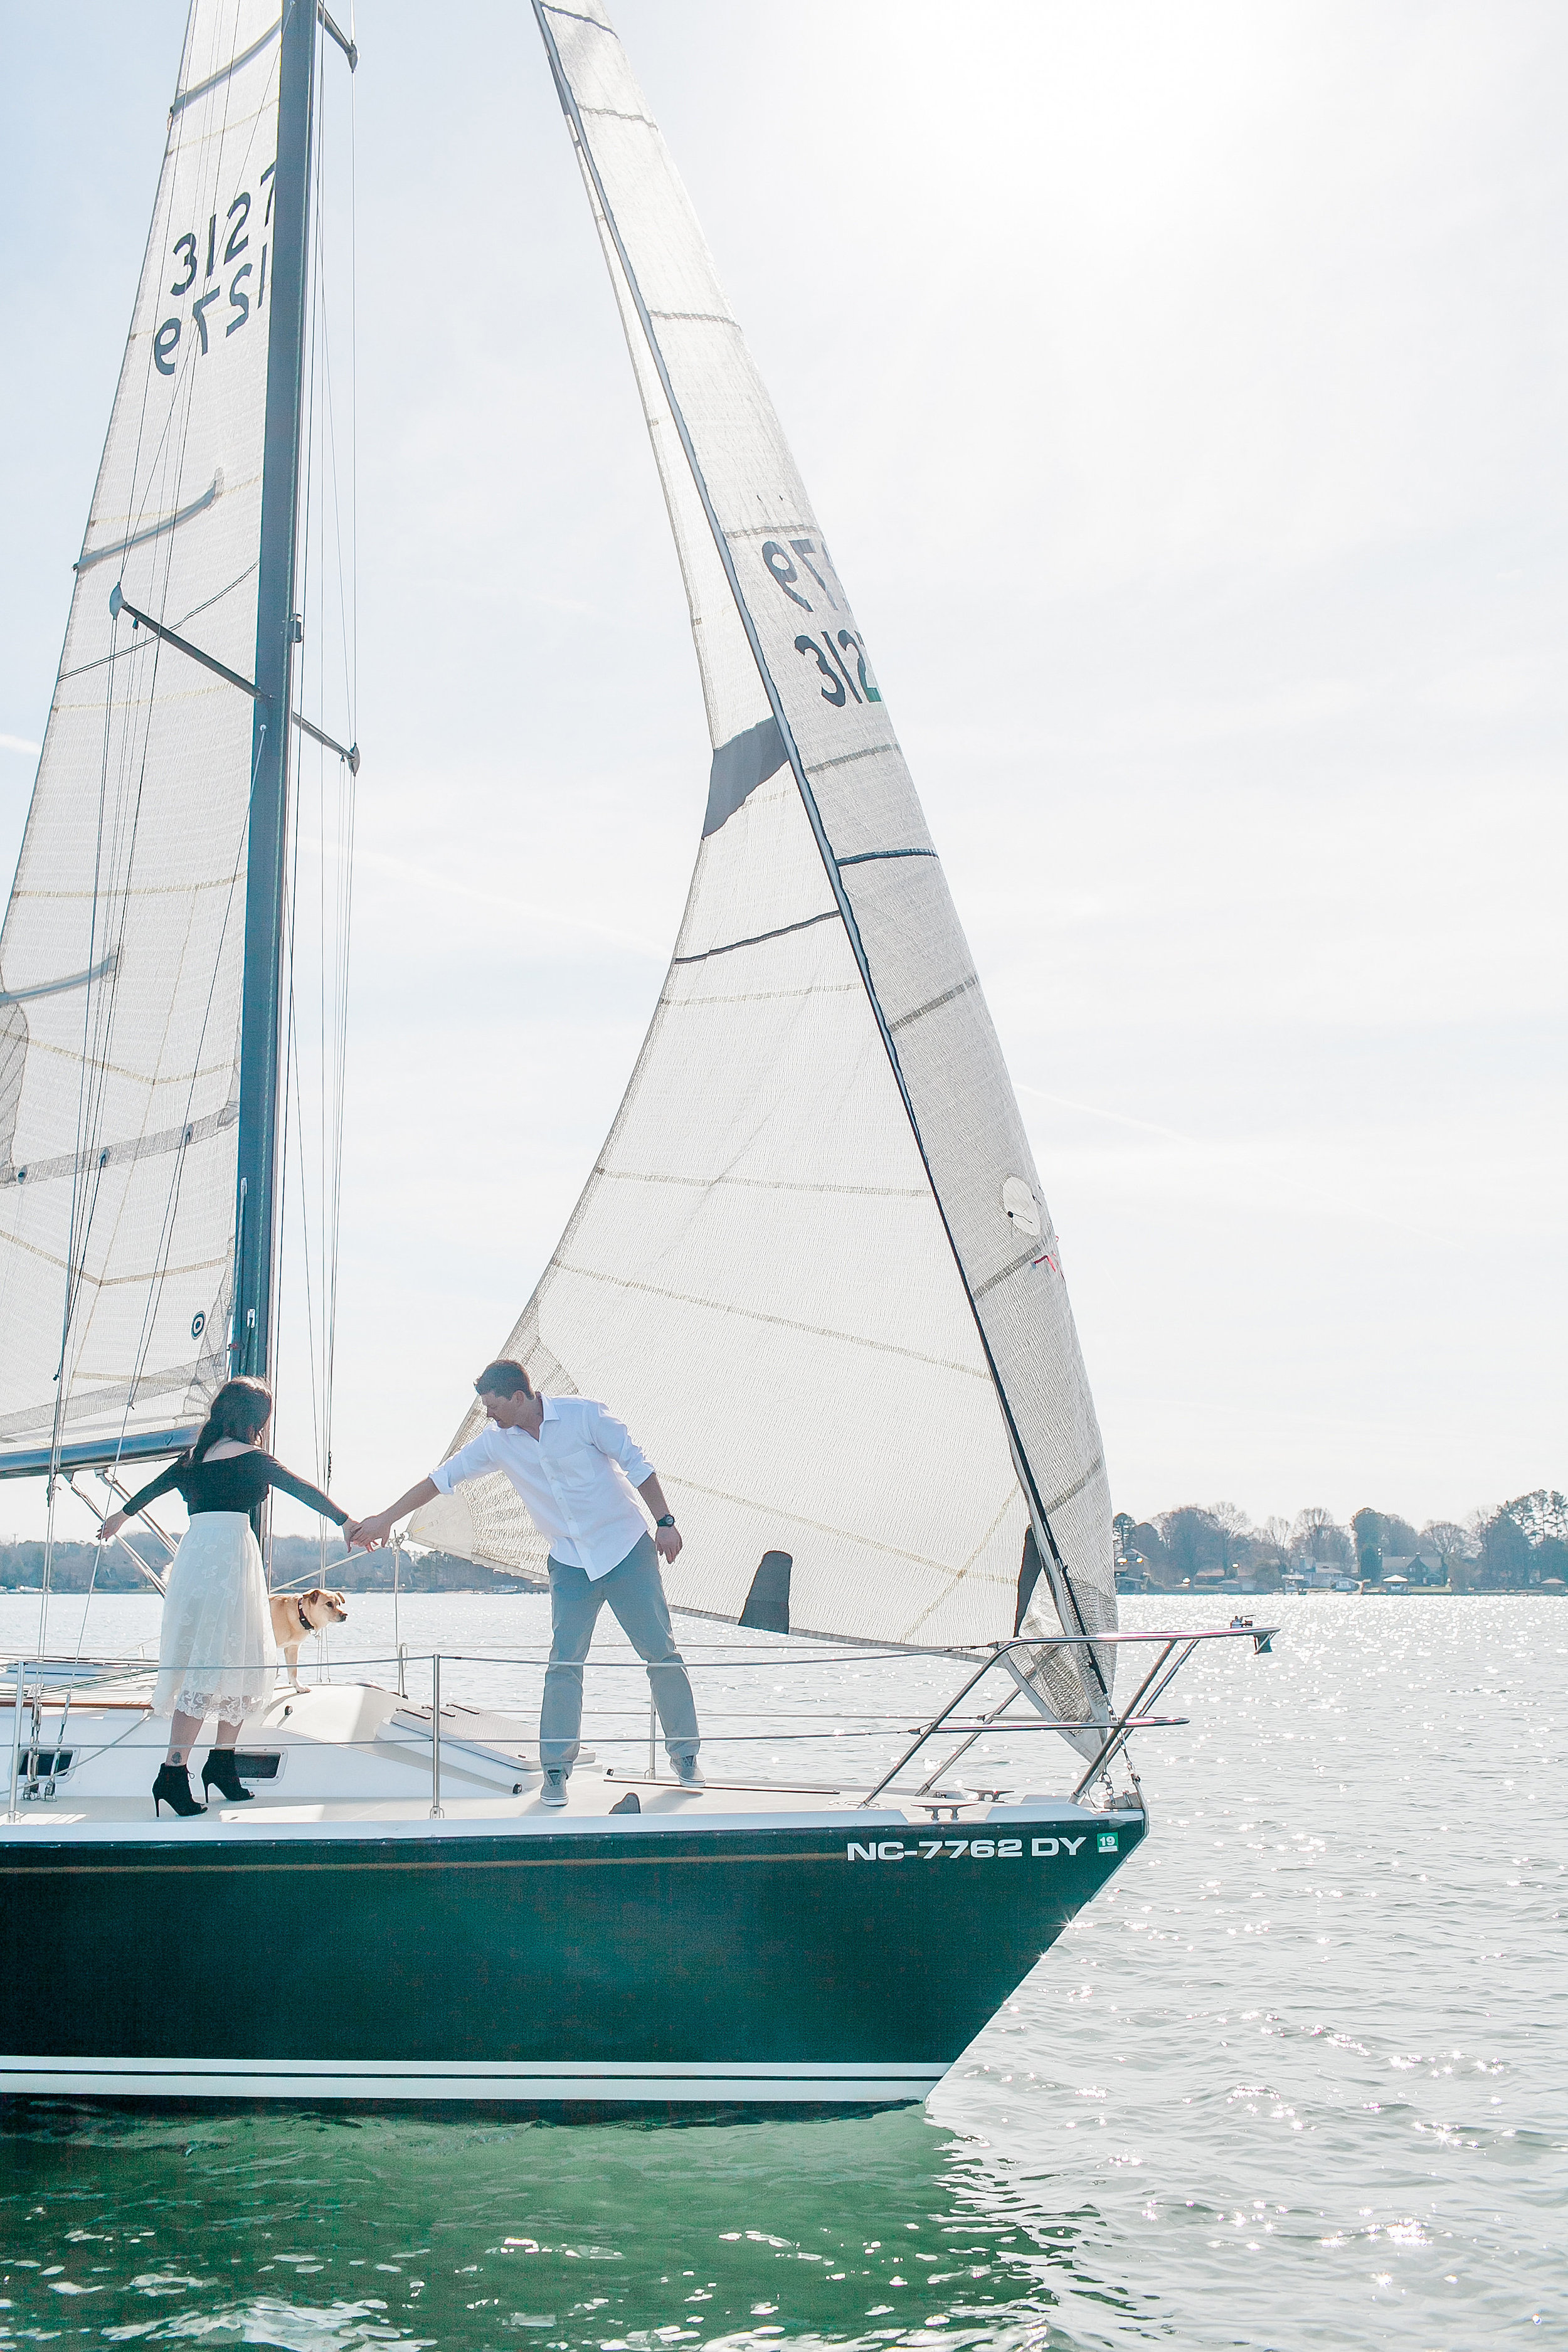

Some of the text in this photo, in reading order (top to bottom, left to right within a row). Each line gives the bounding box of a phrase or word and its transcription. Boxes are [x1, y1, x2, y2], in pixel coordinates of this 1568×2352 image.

[794, 629, 882, 707] 312
[847, 1836, 1086, 1861] NC-7762 DY
[1099, 1836, 1115, 1846] 19
